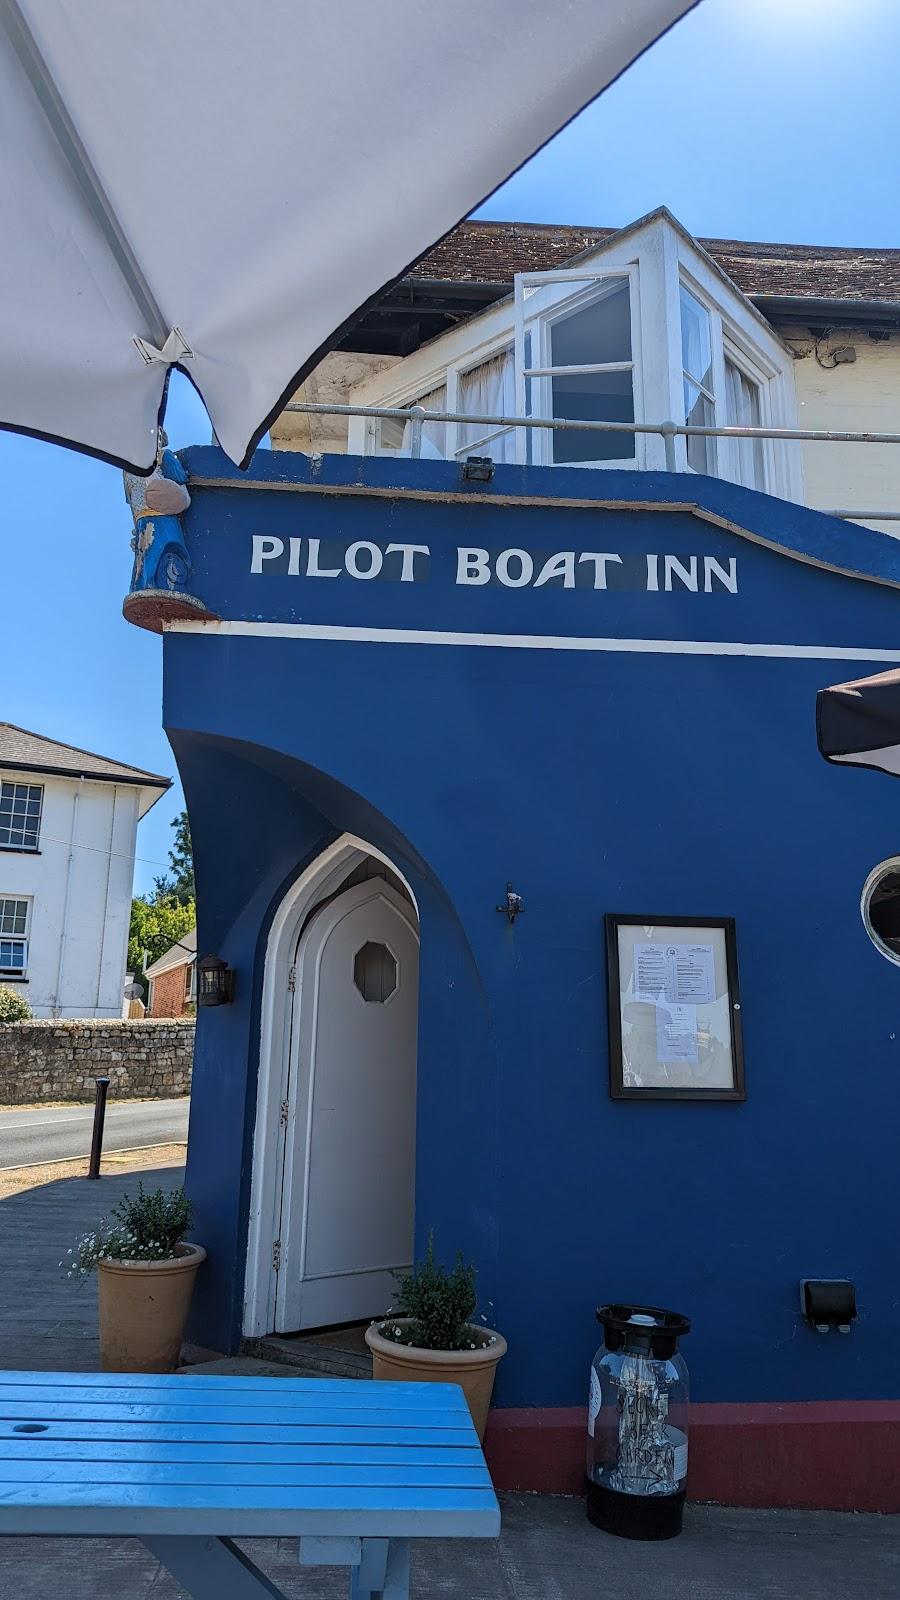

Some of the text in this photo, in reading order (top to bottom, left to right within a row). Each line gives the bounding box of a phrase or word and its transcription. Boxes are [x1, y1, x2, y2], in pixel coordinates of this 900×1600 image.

[251, 535, 738, 593] PILOT BOAT INN
[616, 1394, 672, 1418] SECRE
